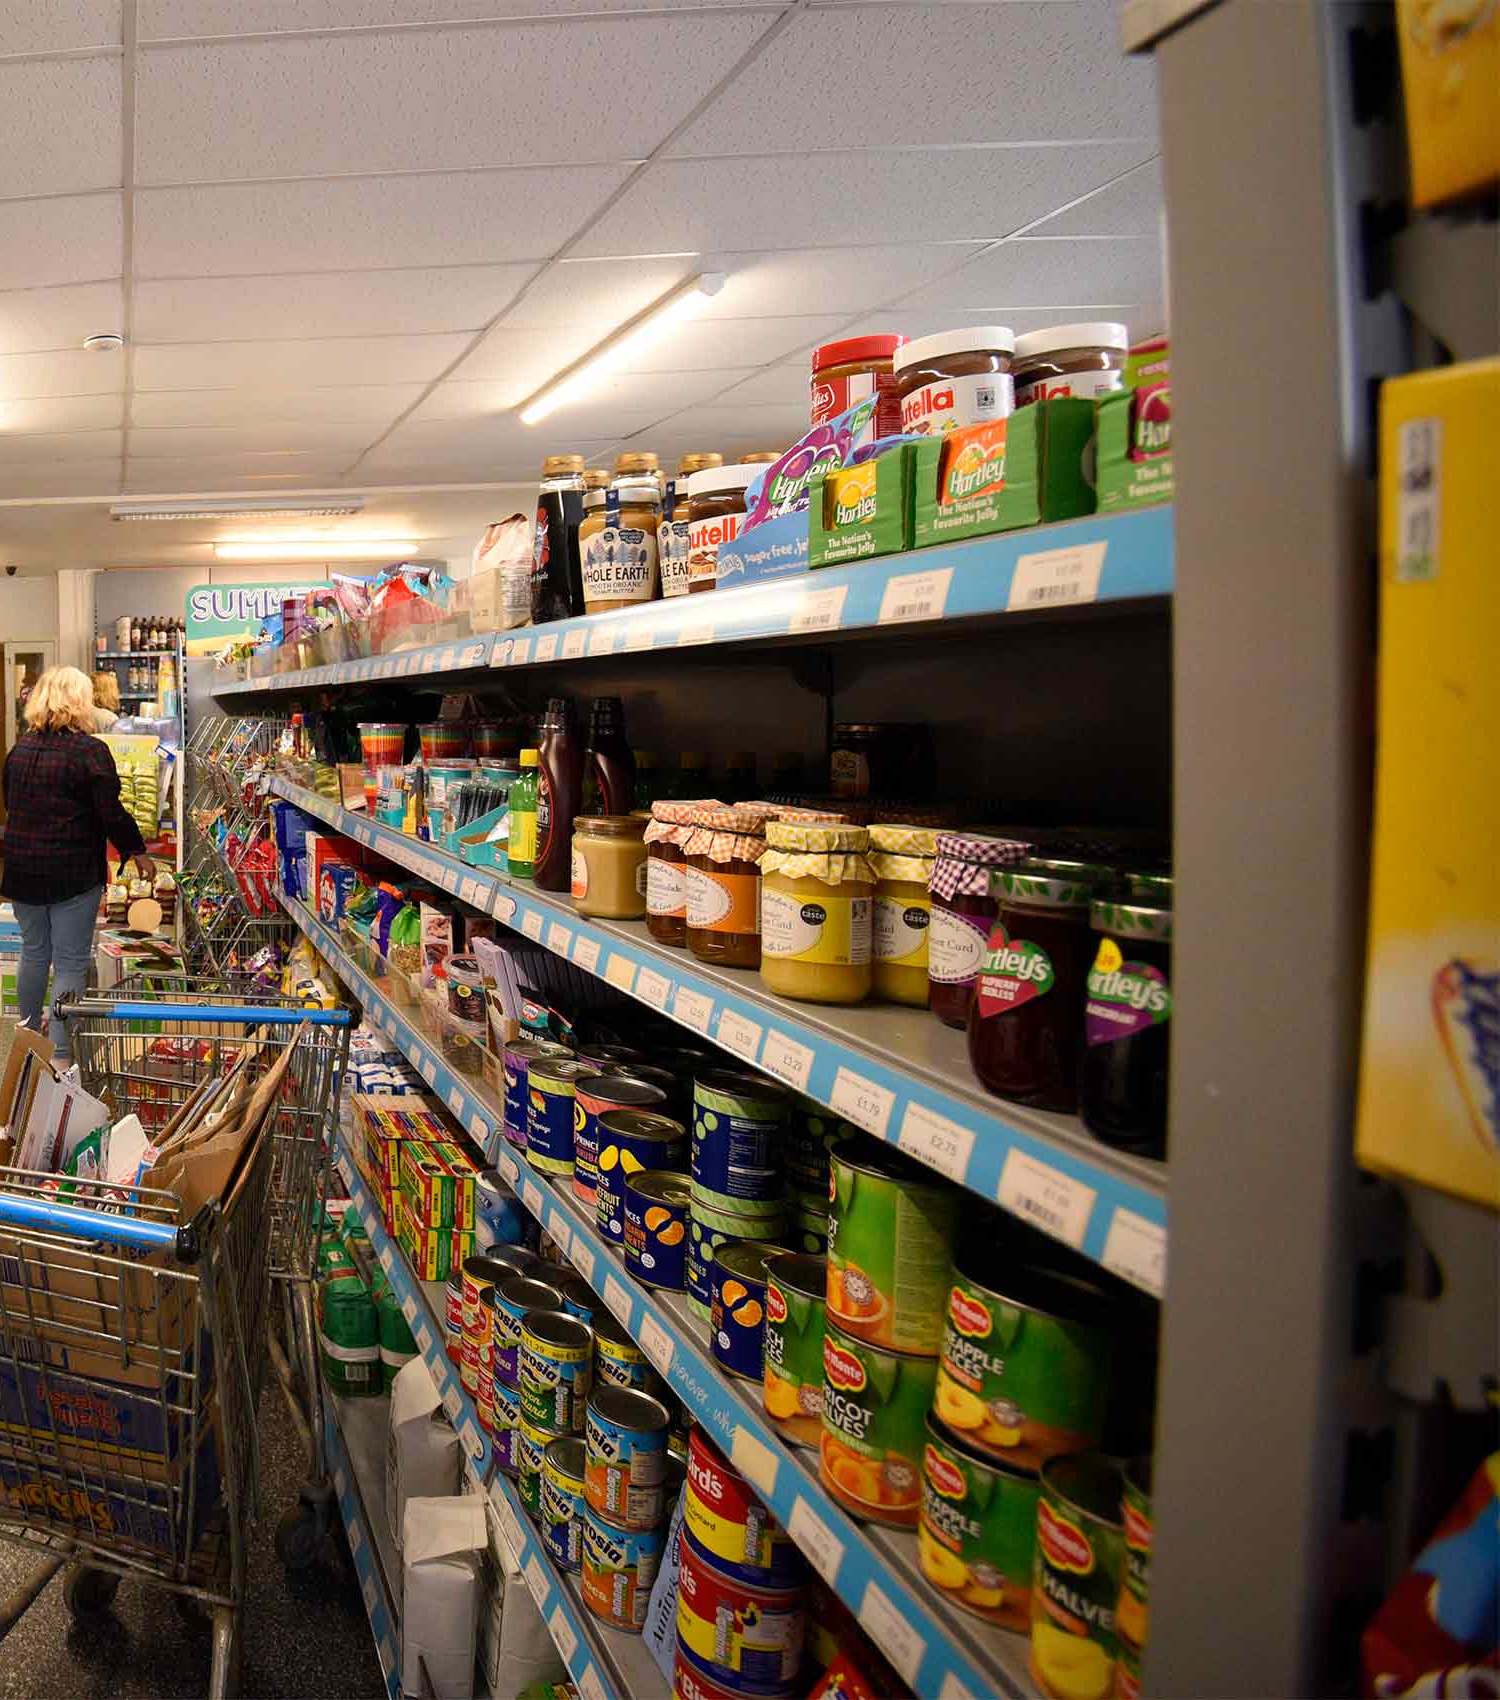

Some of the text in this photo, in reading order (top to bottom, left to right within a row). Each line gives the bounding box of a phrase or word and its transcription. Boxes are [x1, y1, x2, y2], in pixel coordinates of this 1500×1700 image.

[902, 389, 954, 427] utella
[616, 566, 649, 581] EARTH
[191, 588, 308, 623] SUMM
[802, 908, 825, 922] taste
[904, 912, 929, 925] taste
[947, 936, 974, 954] Curd
[575, 1135, 599, 1152] PRINC
[930, 1134, 958, 1157] £2.75
